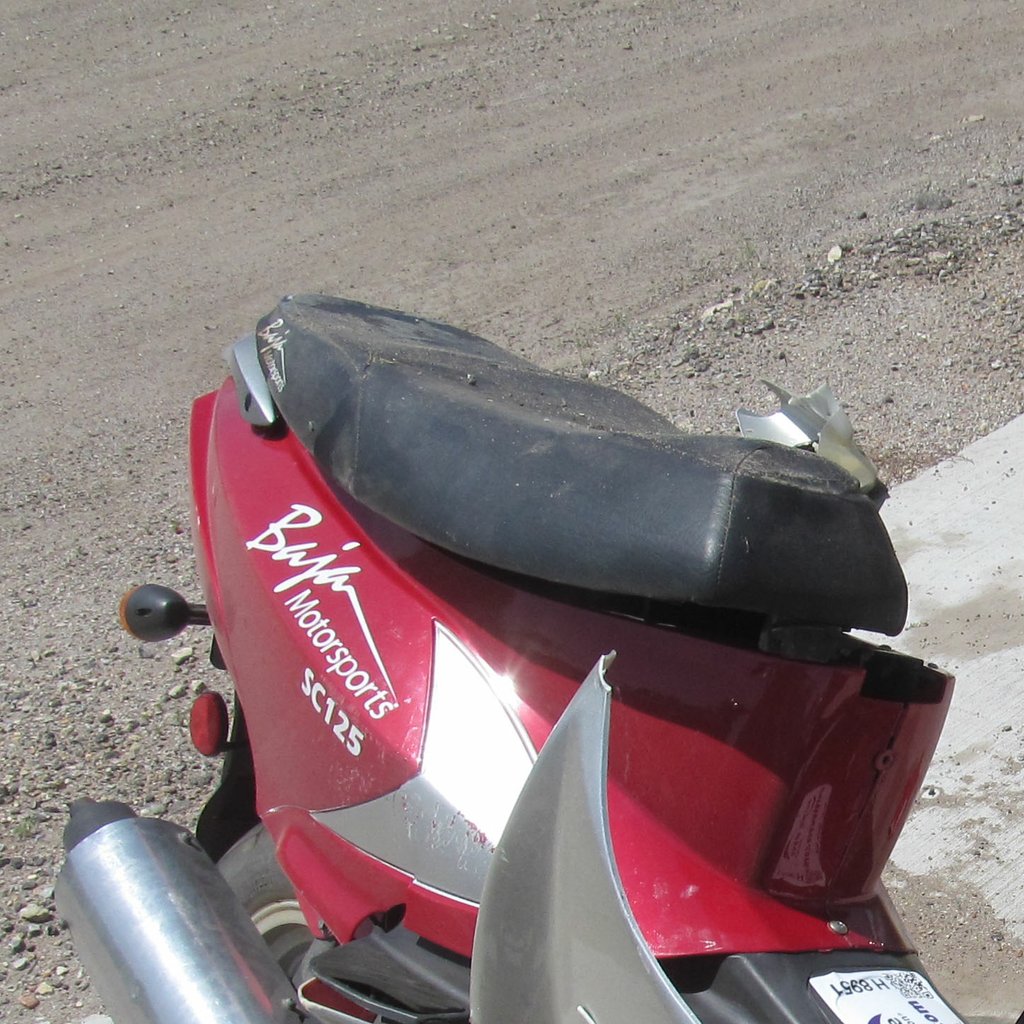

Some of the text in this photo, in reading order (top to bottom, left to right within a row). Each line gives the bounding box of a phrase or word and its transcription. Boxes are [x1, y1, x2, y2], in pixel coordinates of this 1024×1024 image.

[284, 588, 396, 721] Motorsports
[300, 667, 365, 758] SC125
[829, 978, 891, 997] H 8951
